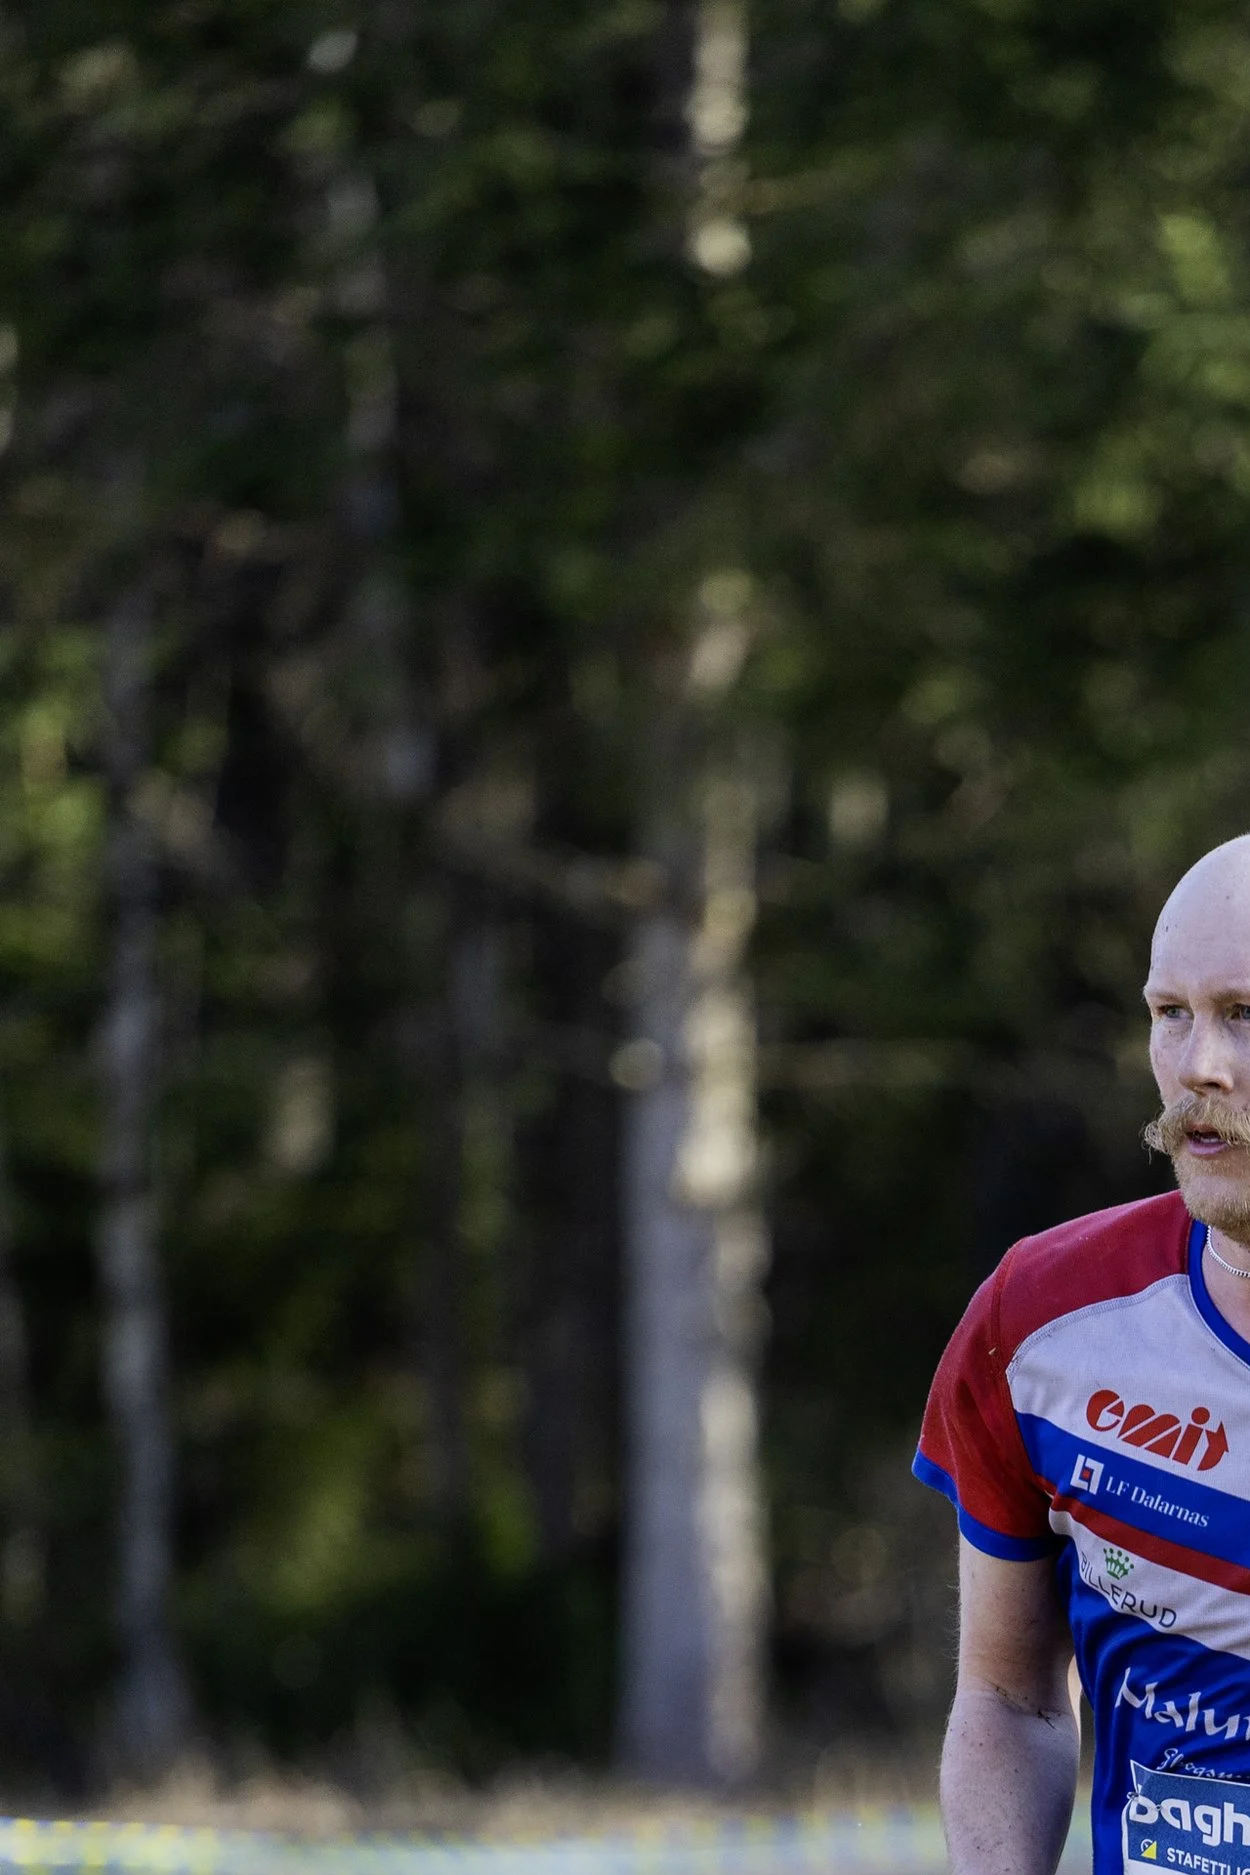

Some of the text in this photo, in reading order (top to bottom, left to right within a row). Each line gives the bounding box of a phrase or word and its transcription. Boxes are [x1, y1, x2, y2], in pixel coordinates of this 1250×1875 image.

[1106, 1475, 1209, 1528] LF Dalarnas
[1081, 1551, 1177, 1628] BILLERUD
